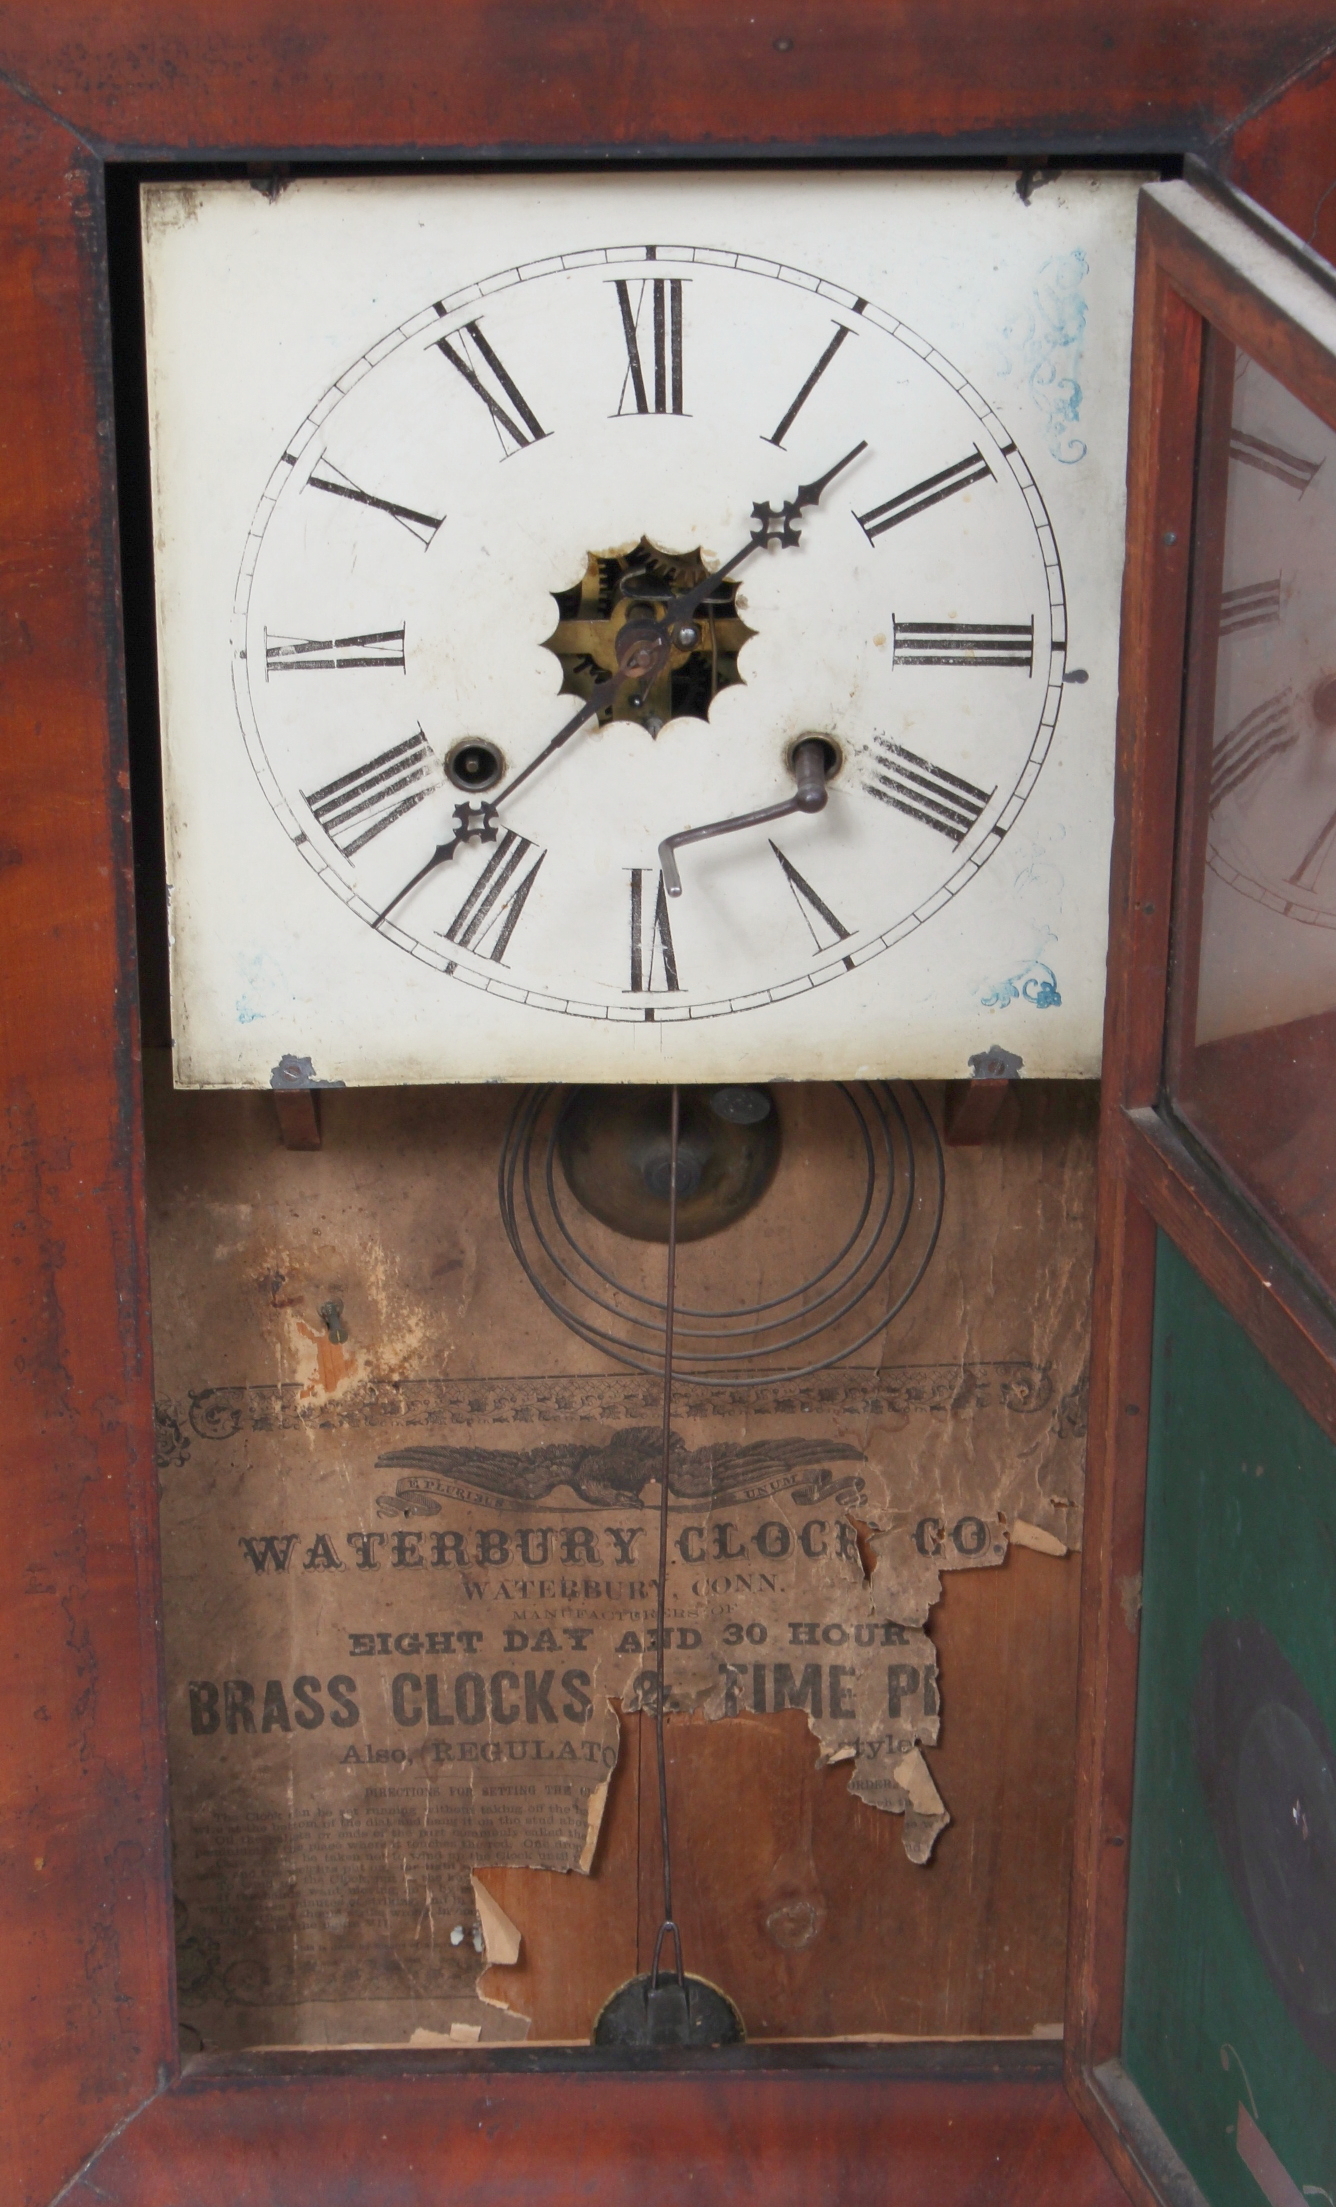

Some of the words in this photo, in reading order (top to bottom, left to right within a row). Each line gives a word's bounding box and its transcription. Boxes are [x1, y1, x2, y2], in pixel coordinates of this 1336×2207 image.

[604, 278, 693, 418] XII
[423, 316, 555, 463] XI
[300, 447, 447, 552] X
[853, 442, 998, 548] II
[264, 624, 406, 683] IX
[891, 612, 1034, 678] III
[743, 1474, 797, 1500] UNUM
[238, 1524, 648, 1575] WATERBURY
[691, 1572, 786, 1599] CONN.
[348, 1630, 484, 1657] EIGHT
[502, 1627, 595, 1654] DAY
[614, 1626, 703, 1654] AND
[722, 1622, 768, 1647] 30
[788, 1620, 911, 1648] HOUR
[188, 1673, 362, 1736] BRASS
[391, 1668, 596, 1731] CLOCKS
[717, 1662, 857, 1719] TIME
[339, 1744, 413, 1767] Also,
[364, 1786, 441, 1799] DIRECTIONS
[449, 1785, 474, 1797] FOR
[482, 1785, 536, 1797] SETTING
[545, 1784, 572, 1796] THE
